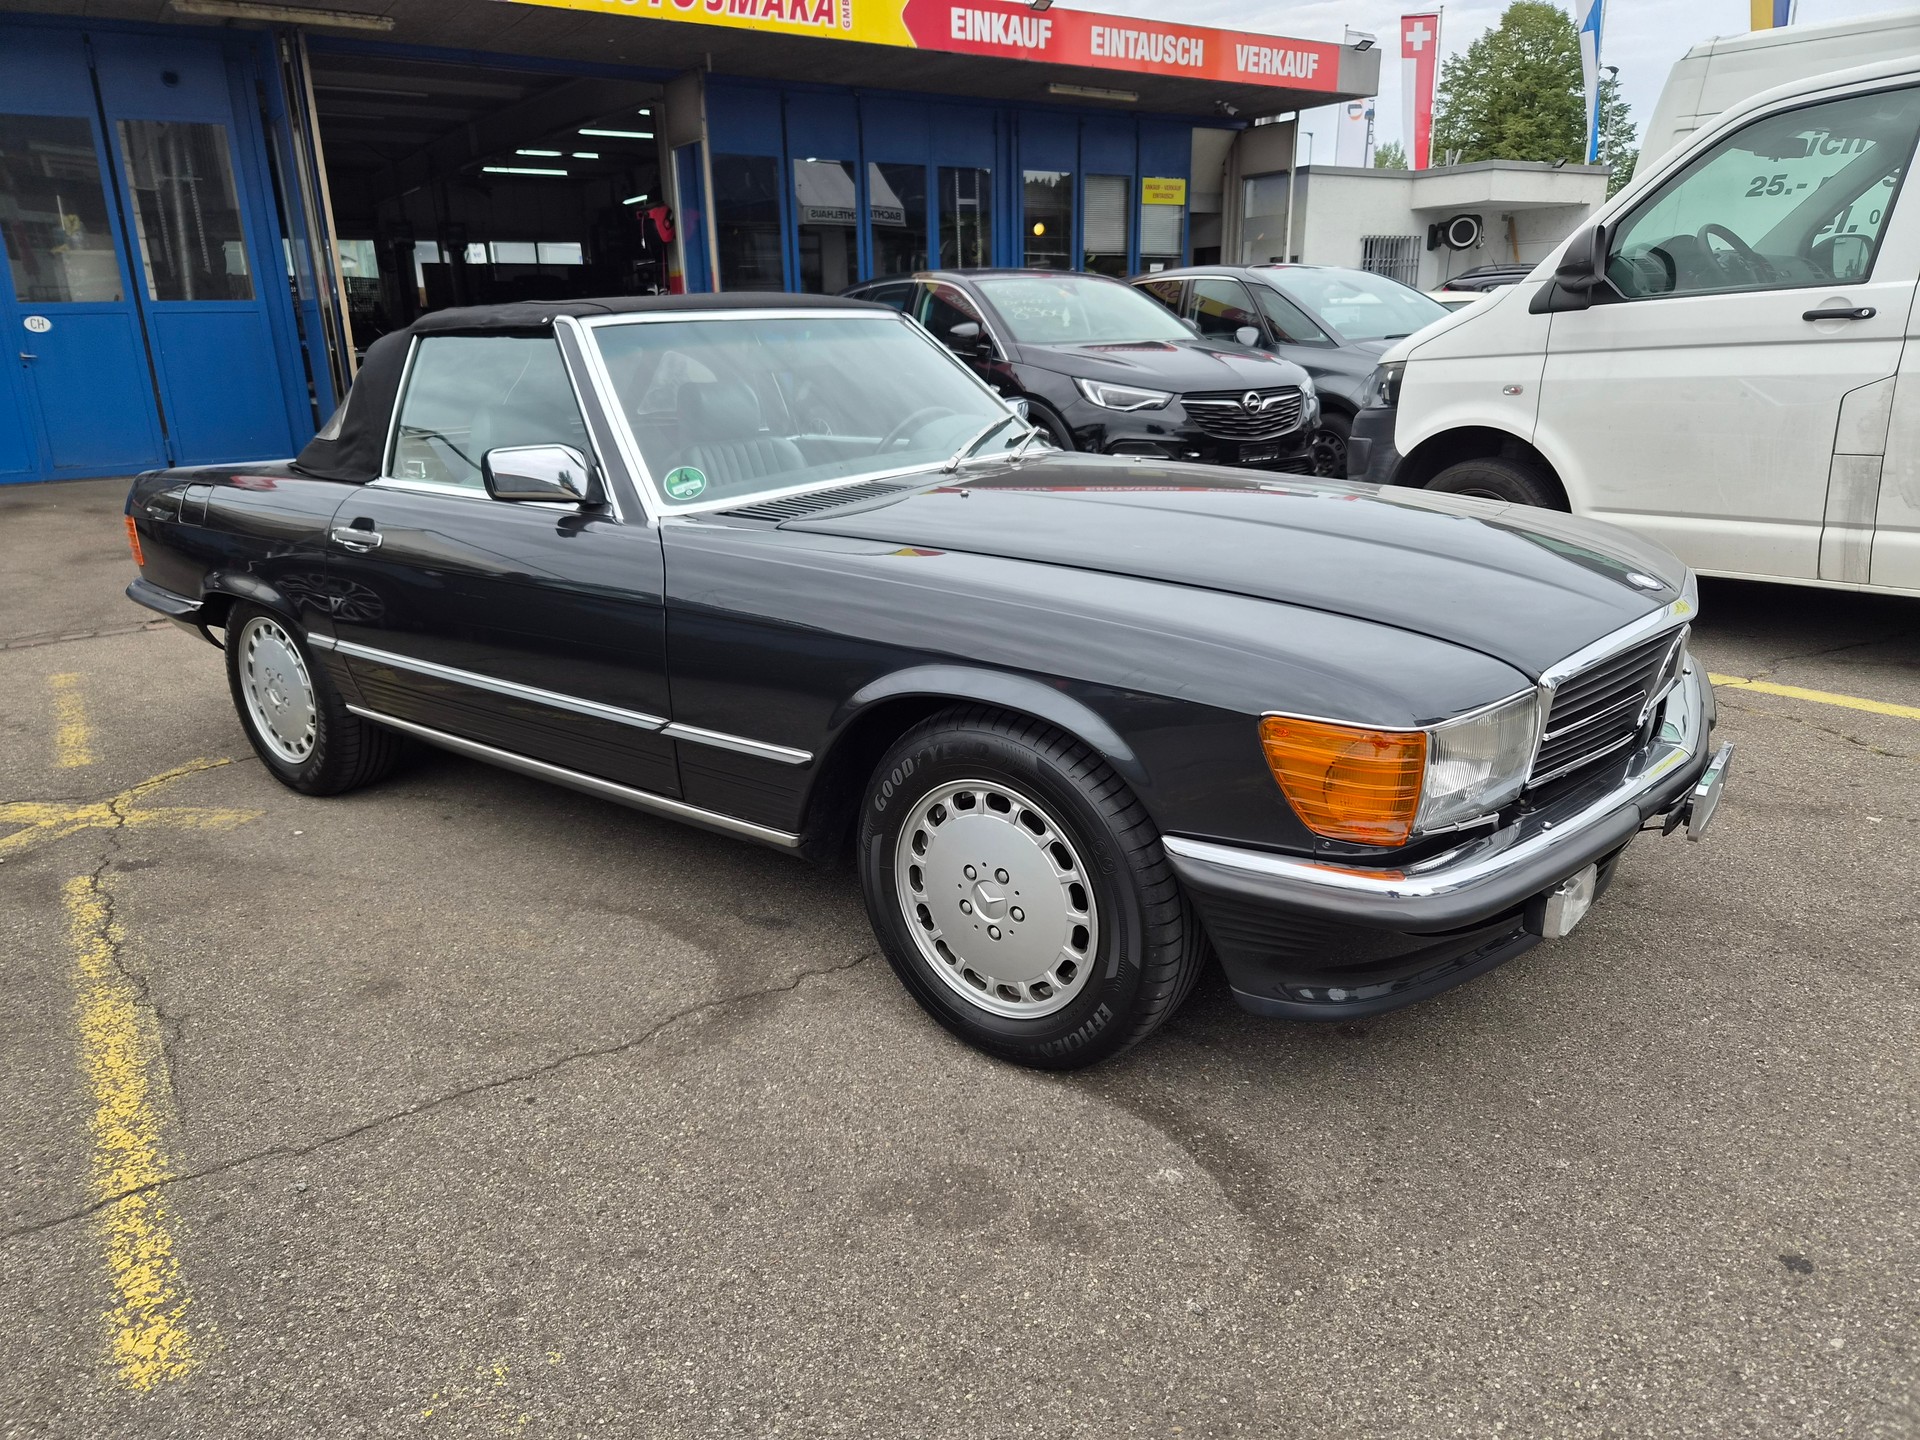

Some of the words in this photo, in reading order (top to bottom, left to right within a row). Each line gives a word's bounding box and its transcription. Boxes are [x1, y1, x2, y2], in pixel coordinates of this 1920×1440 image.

[950, 7, 1052, 49] EINKAUF
[1090, 25, 1204, 67] EINTAUSCH
[1236, 44, 1319, 79] VERKAUF
[1745, 174, 1808, 198] 25.-
[30, 318, 45, 329] CH
[679, 469, 689, 482] 4
